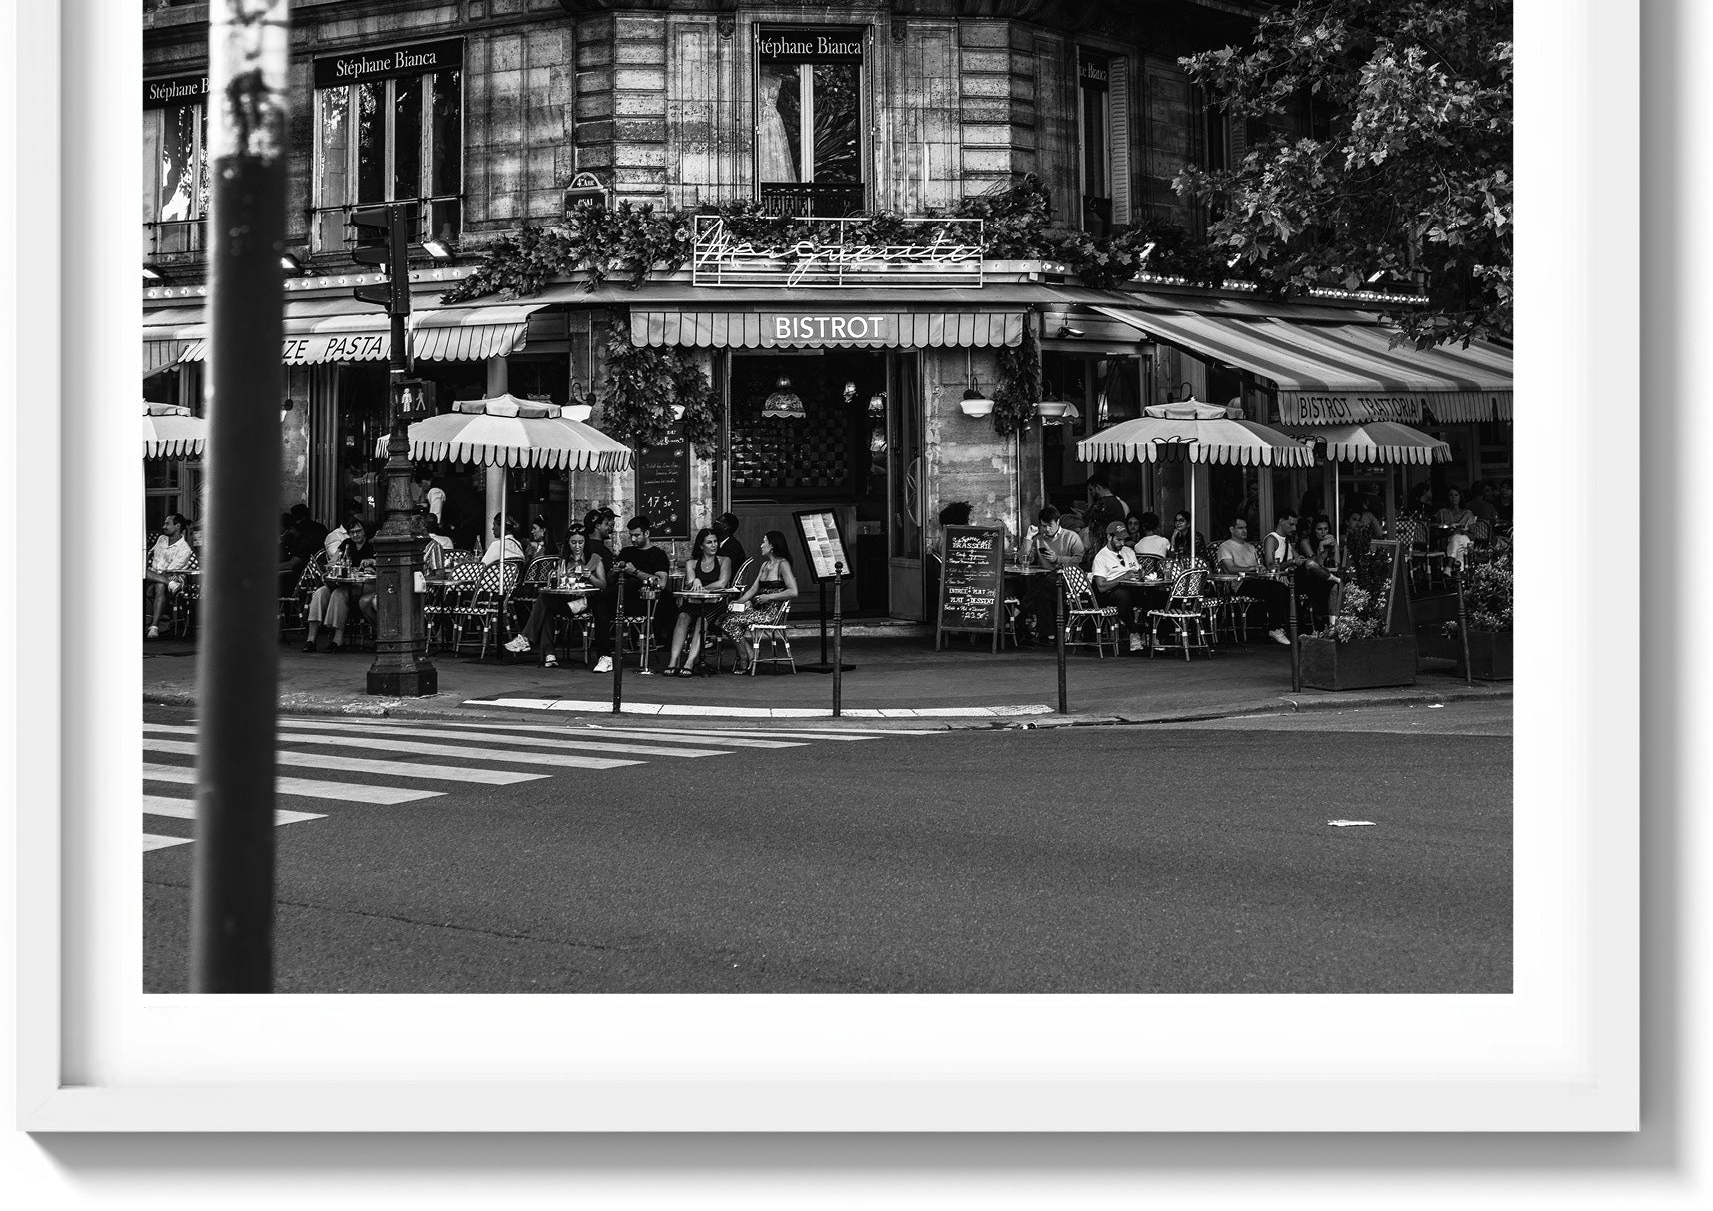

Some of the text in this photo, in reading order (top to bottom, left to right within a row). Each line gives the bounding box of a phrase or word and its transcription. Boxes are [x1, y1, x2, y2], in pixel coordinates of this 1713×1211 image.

[759, 36, 862, 58] téphane Bianca
[336, 50, 437, 79] Stéphane Bianca
[150, 81, 198, 102] Stéphane
[776, 316, 884, 339] BISTROT
[324, 336, 382, 357] PASTA
[1299, 396, 1418, 419] BISTROT TRATTORIA
